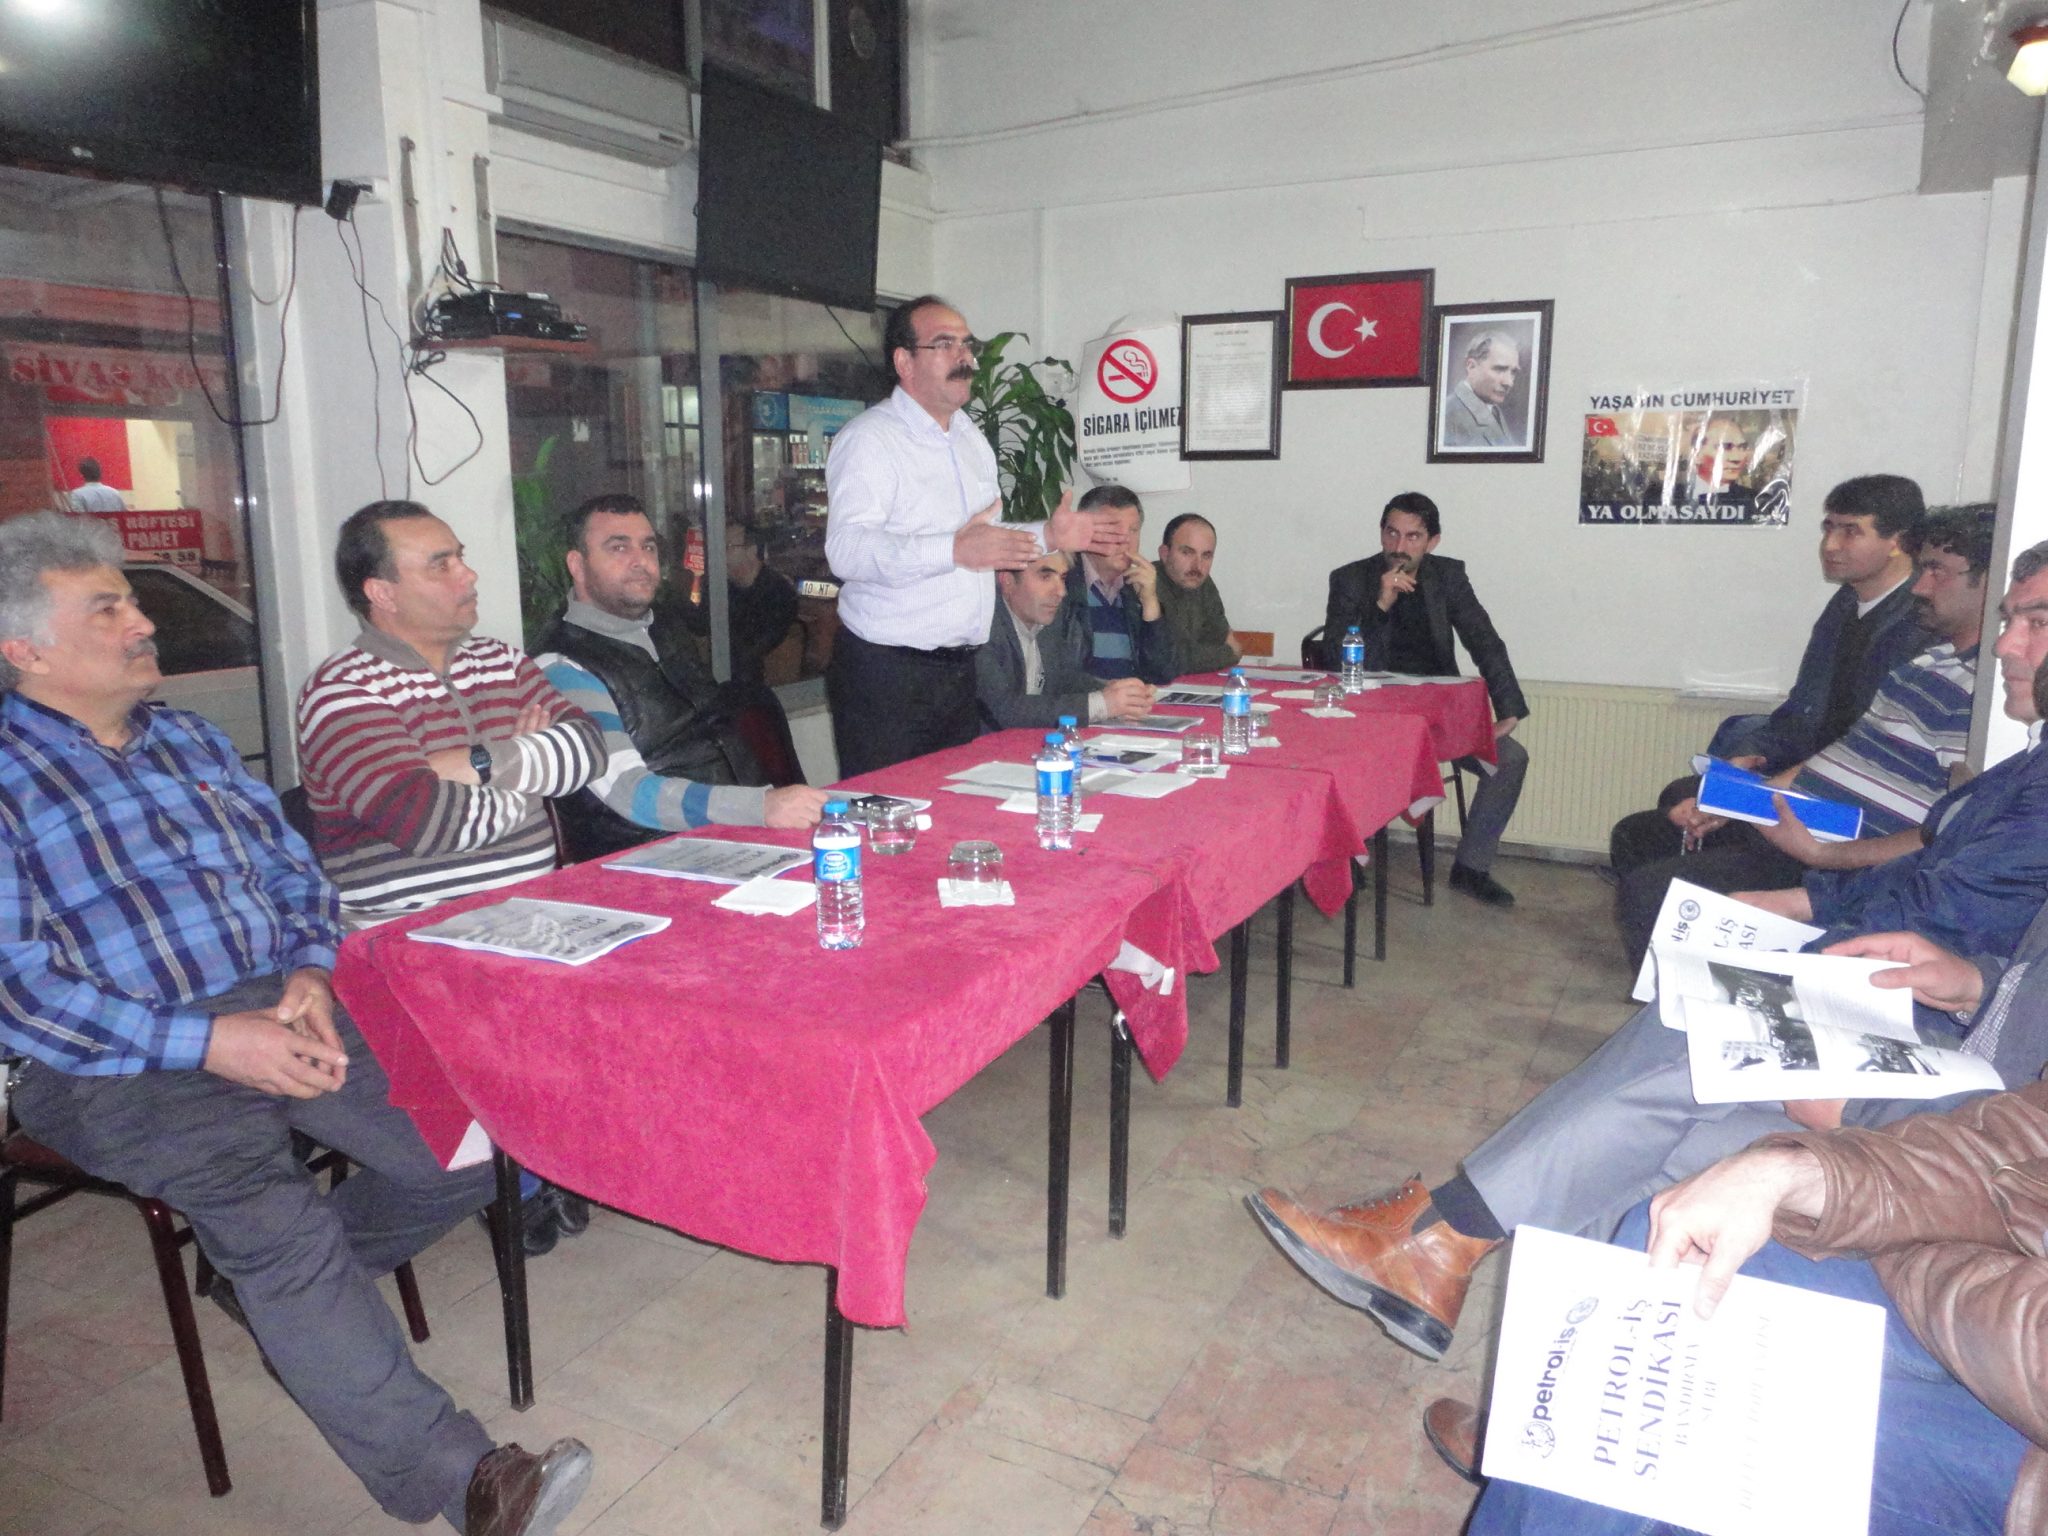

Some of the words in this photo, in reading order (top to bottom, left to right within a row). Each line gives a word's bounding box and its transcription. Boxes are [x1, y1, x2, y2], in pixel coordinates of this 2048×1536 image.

[1670, 387, 1796, 407] CUMHURİYET
[1083, 412, 1131, 437] SİGARA
[1588, 504, 1614, 520] YA
[1620, 502, 1745, 521] OLMASAYDI
[1633, 1300, 1682, 1480] SENDİKASI
